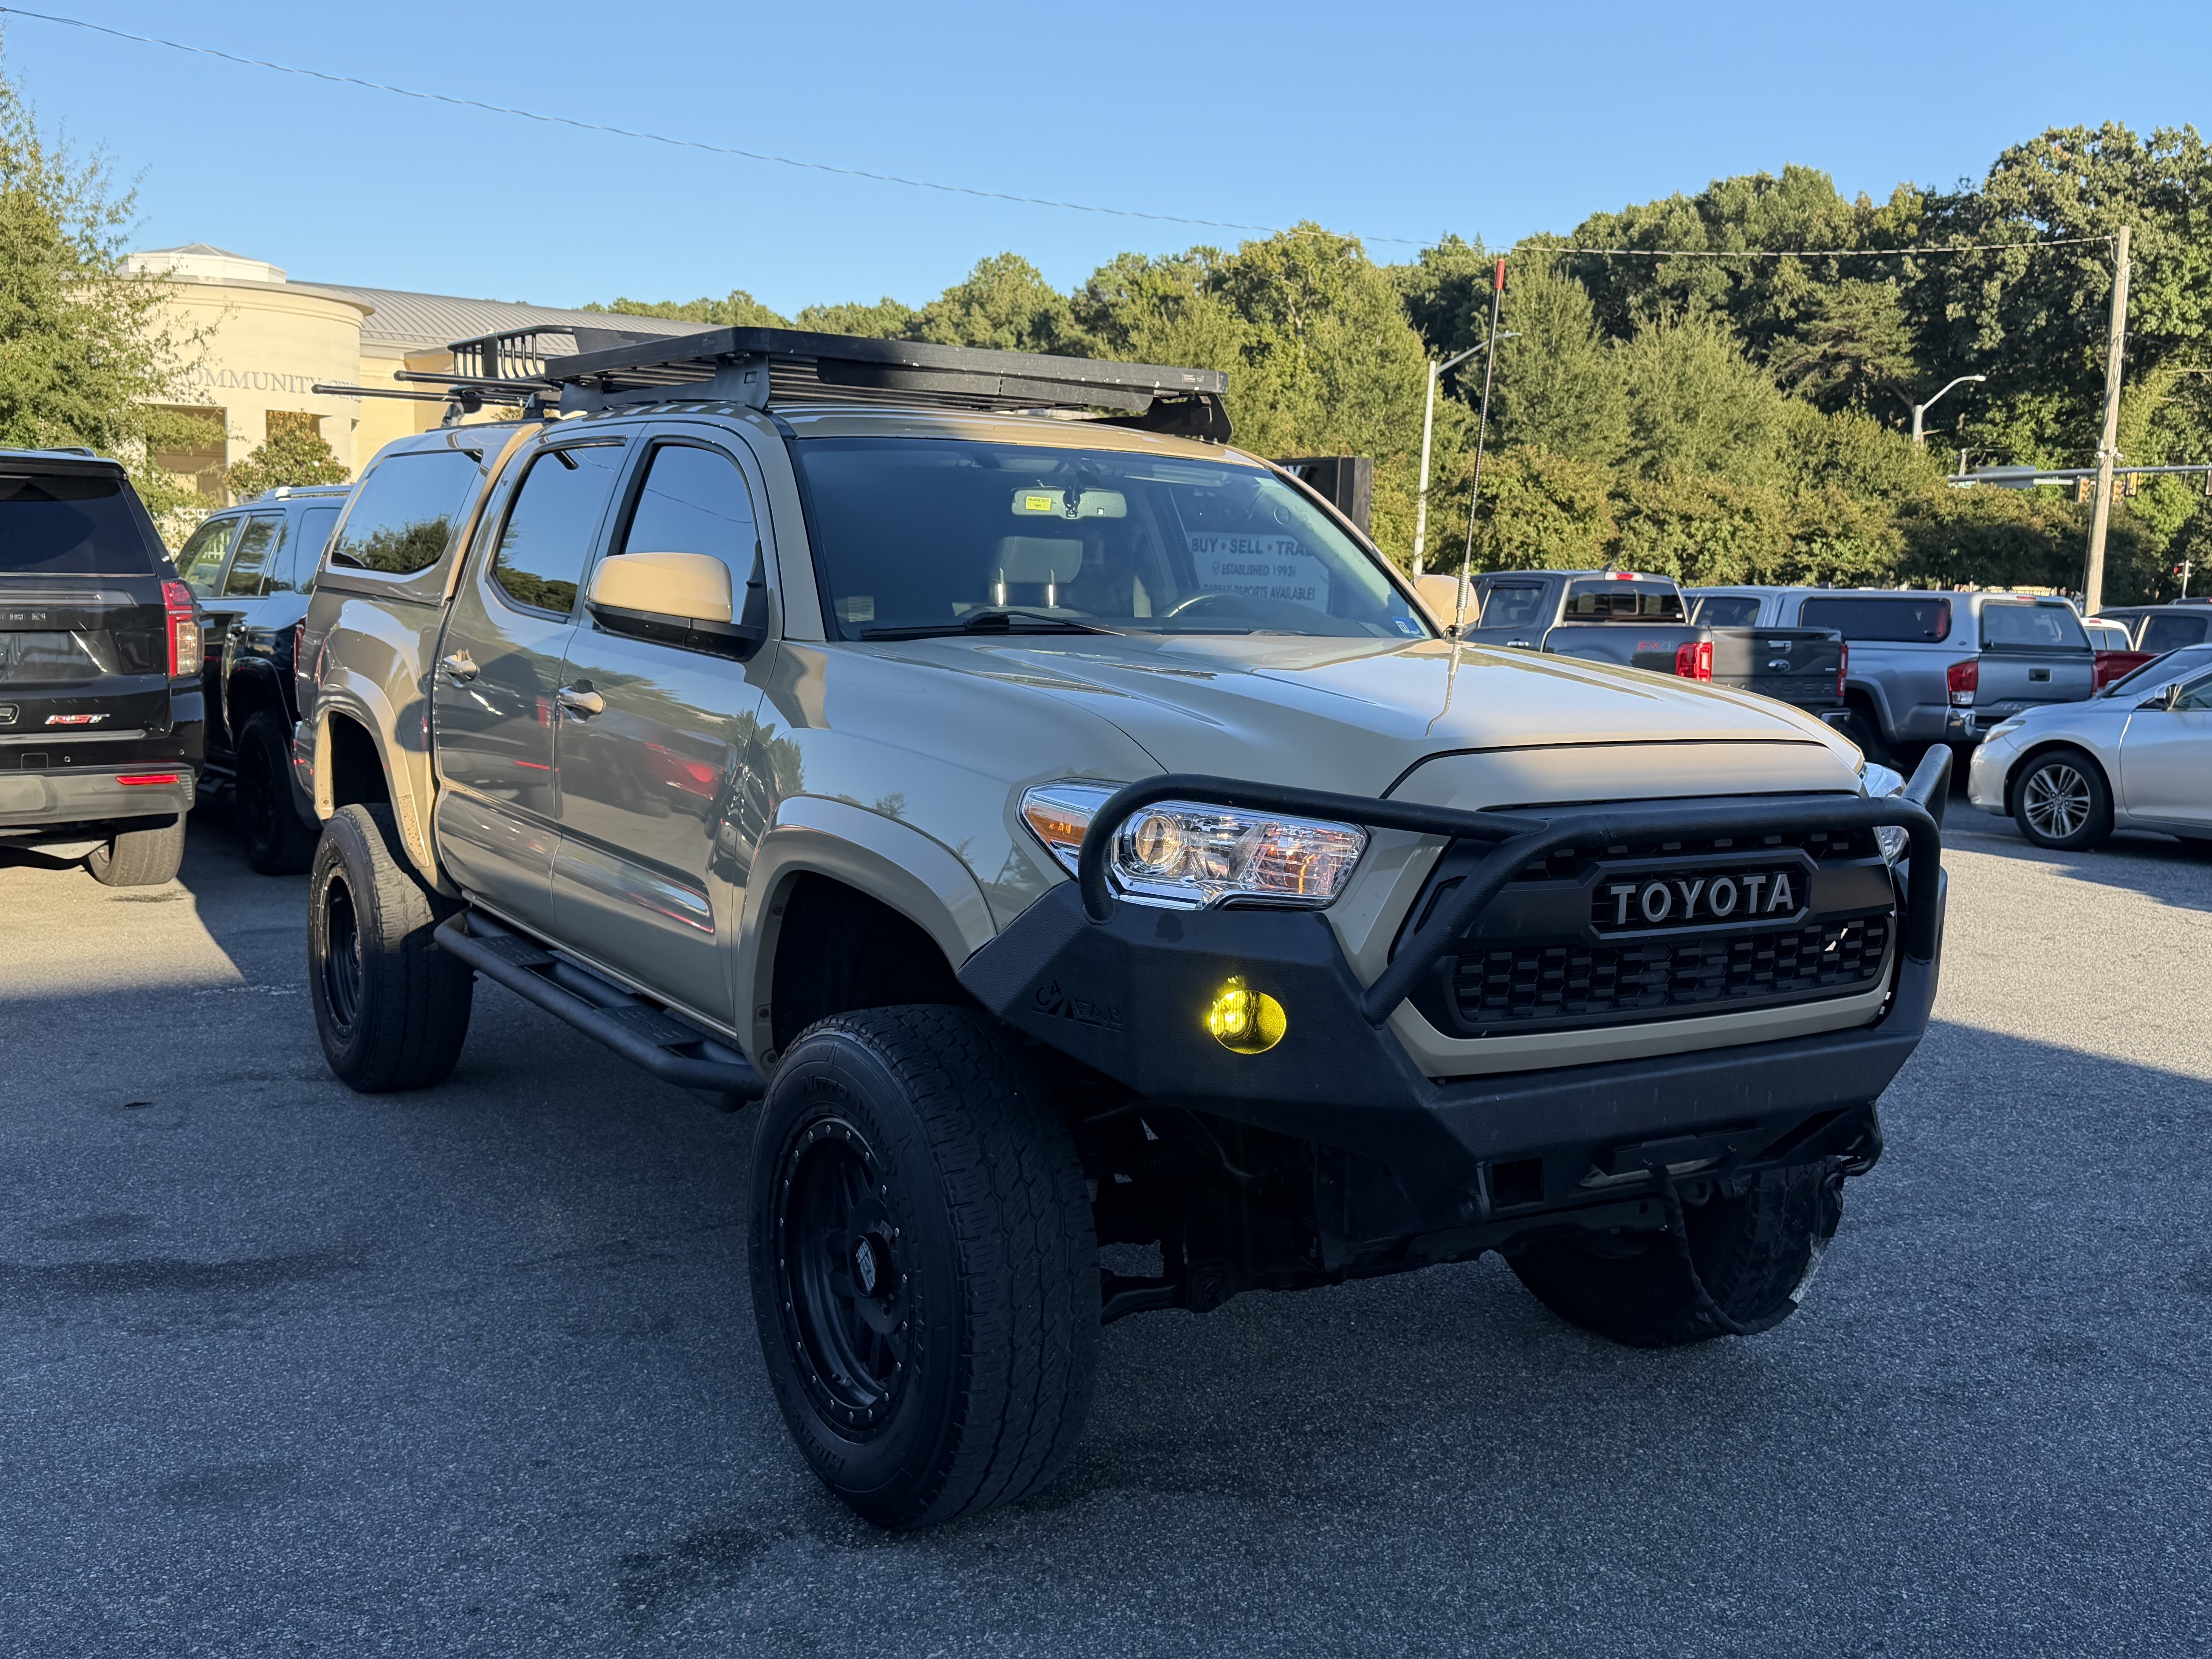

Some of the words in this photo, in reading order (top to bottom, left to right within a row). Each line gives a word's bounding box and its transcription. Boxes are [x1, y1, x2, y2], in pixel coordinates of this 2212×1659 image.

[1191, 538, 1218, 553] BUY
[1230, 539, 1263, 554] SELL
[1221, 563, 1269, 576] ESTABLISHED
[1270, 586, 1316, 601] AVAILABLE!
[1638, 641, 1673, 651] FX4
[1606, 872, 1794, 925] TOYOTA
